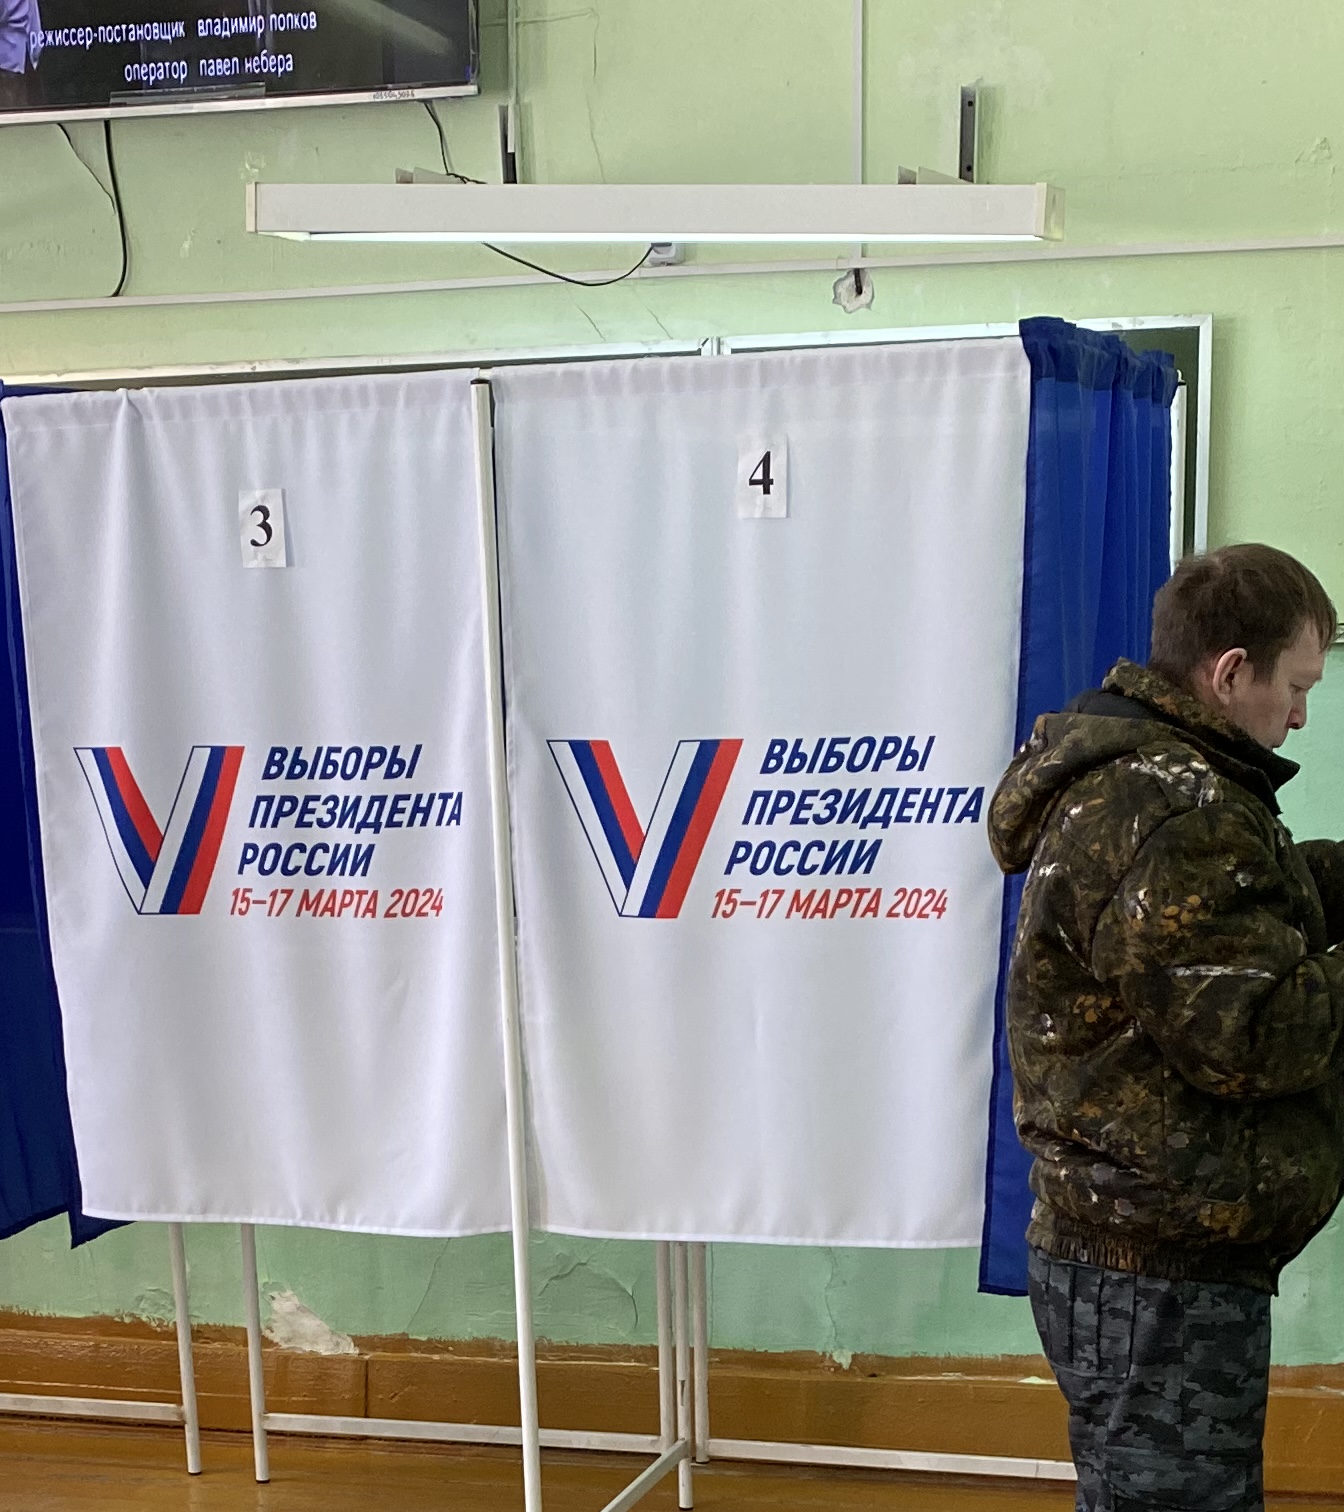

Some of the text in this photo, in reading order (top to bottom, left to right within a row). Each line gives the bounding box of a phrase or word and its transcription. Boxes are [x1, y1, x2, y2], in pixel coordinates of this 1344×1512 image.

[30, 11, 317, 50] режиссер-постановщик владимир попков
[124, 50, 294, 85] оператор павел небера
[747, 450, 775, 495] 4
[249, 505, 274, 547] 3
[262, 746, 421, 781] ВЫБОРЫ
[759, 735, 935, 775] ВЫБОРЫ
[248, 792, 464, 833] ПРЕЗИДЕНТА
[743, 787, 985, 829] ПРЕЗИДЕНТА
[238, 842, 376, 876] РОССИИ
[724, 839, 882, 876] РОССИИ
[296, 889, 380, 918] МАРТА
[383, 888, 444, 919] 2024
[785, 887, 883, 919] МАРТА
[885, 888, 947, 919] 2024
